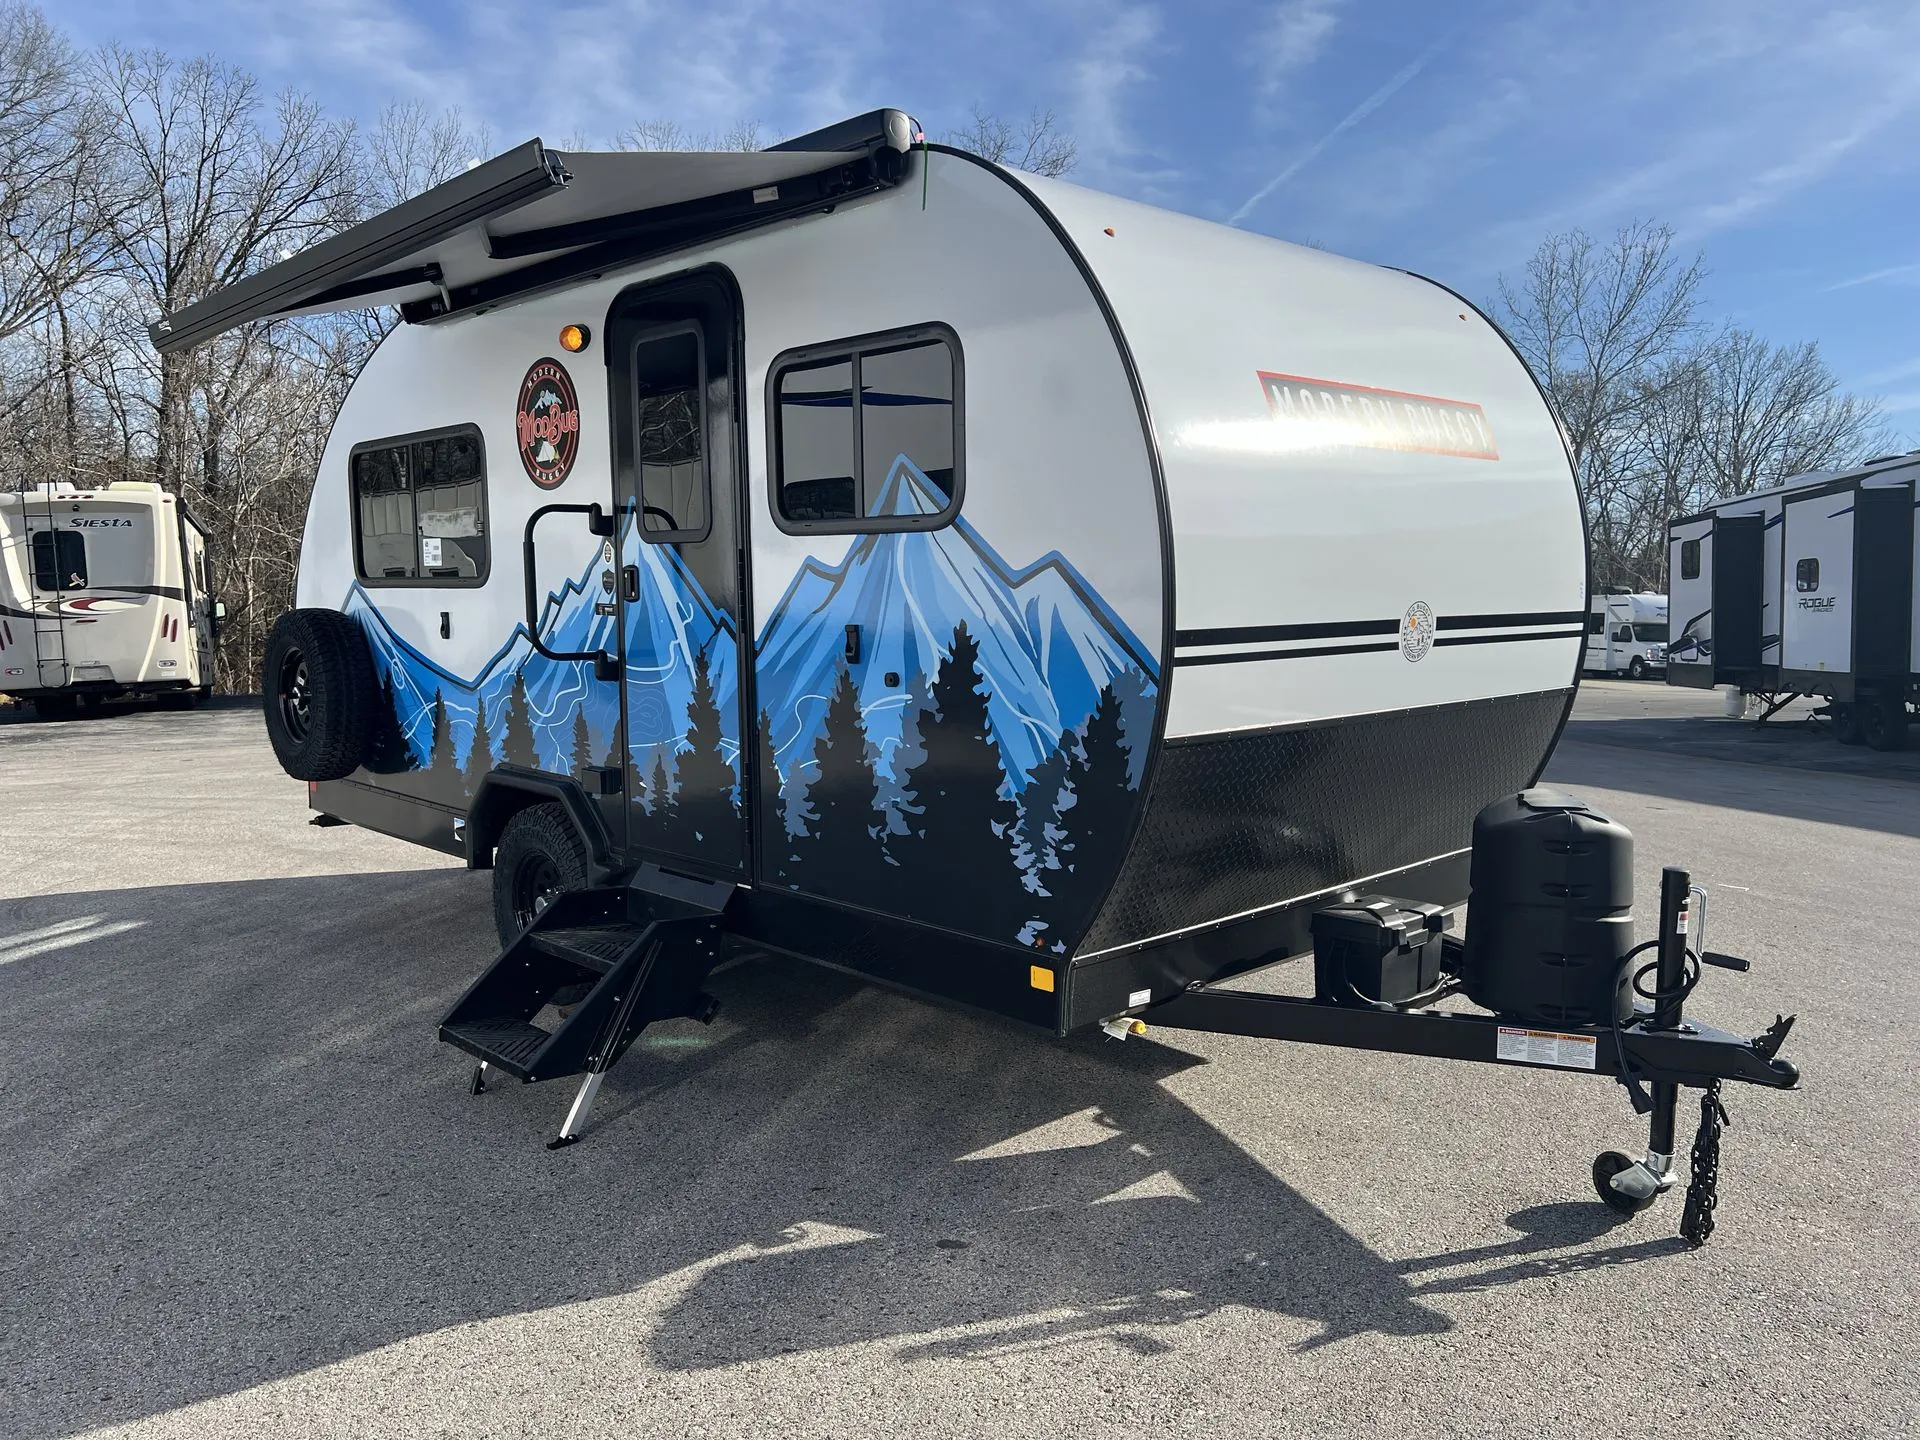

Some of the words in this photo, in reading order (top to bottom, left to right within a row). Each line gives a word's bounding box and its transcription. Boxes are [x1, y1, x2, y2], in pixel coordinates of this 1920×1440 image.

[528, 367, 561, 390] MODERN
[535, 463, 565, 481] BUGGY
[1798, 597, 1836, 610] ROGUE
